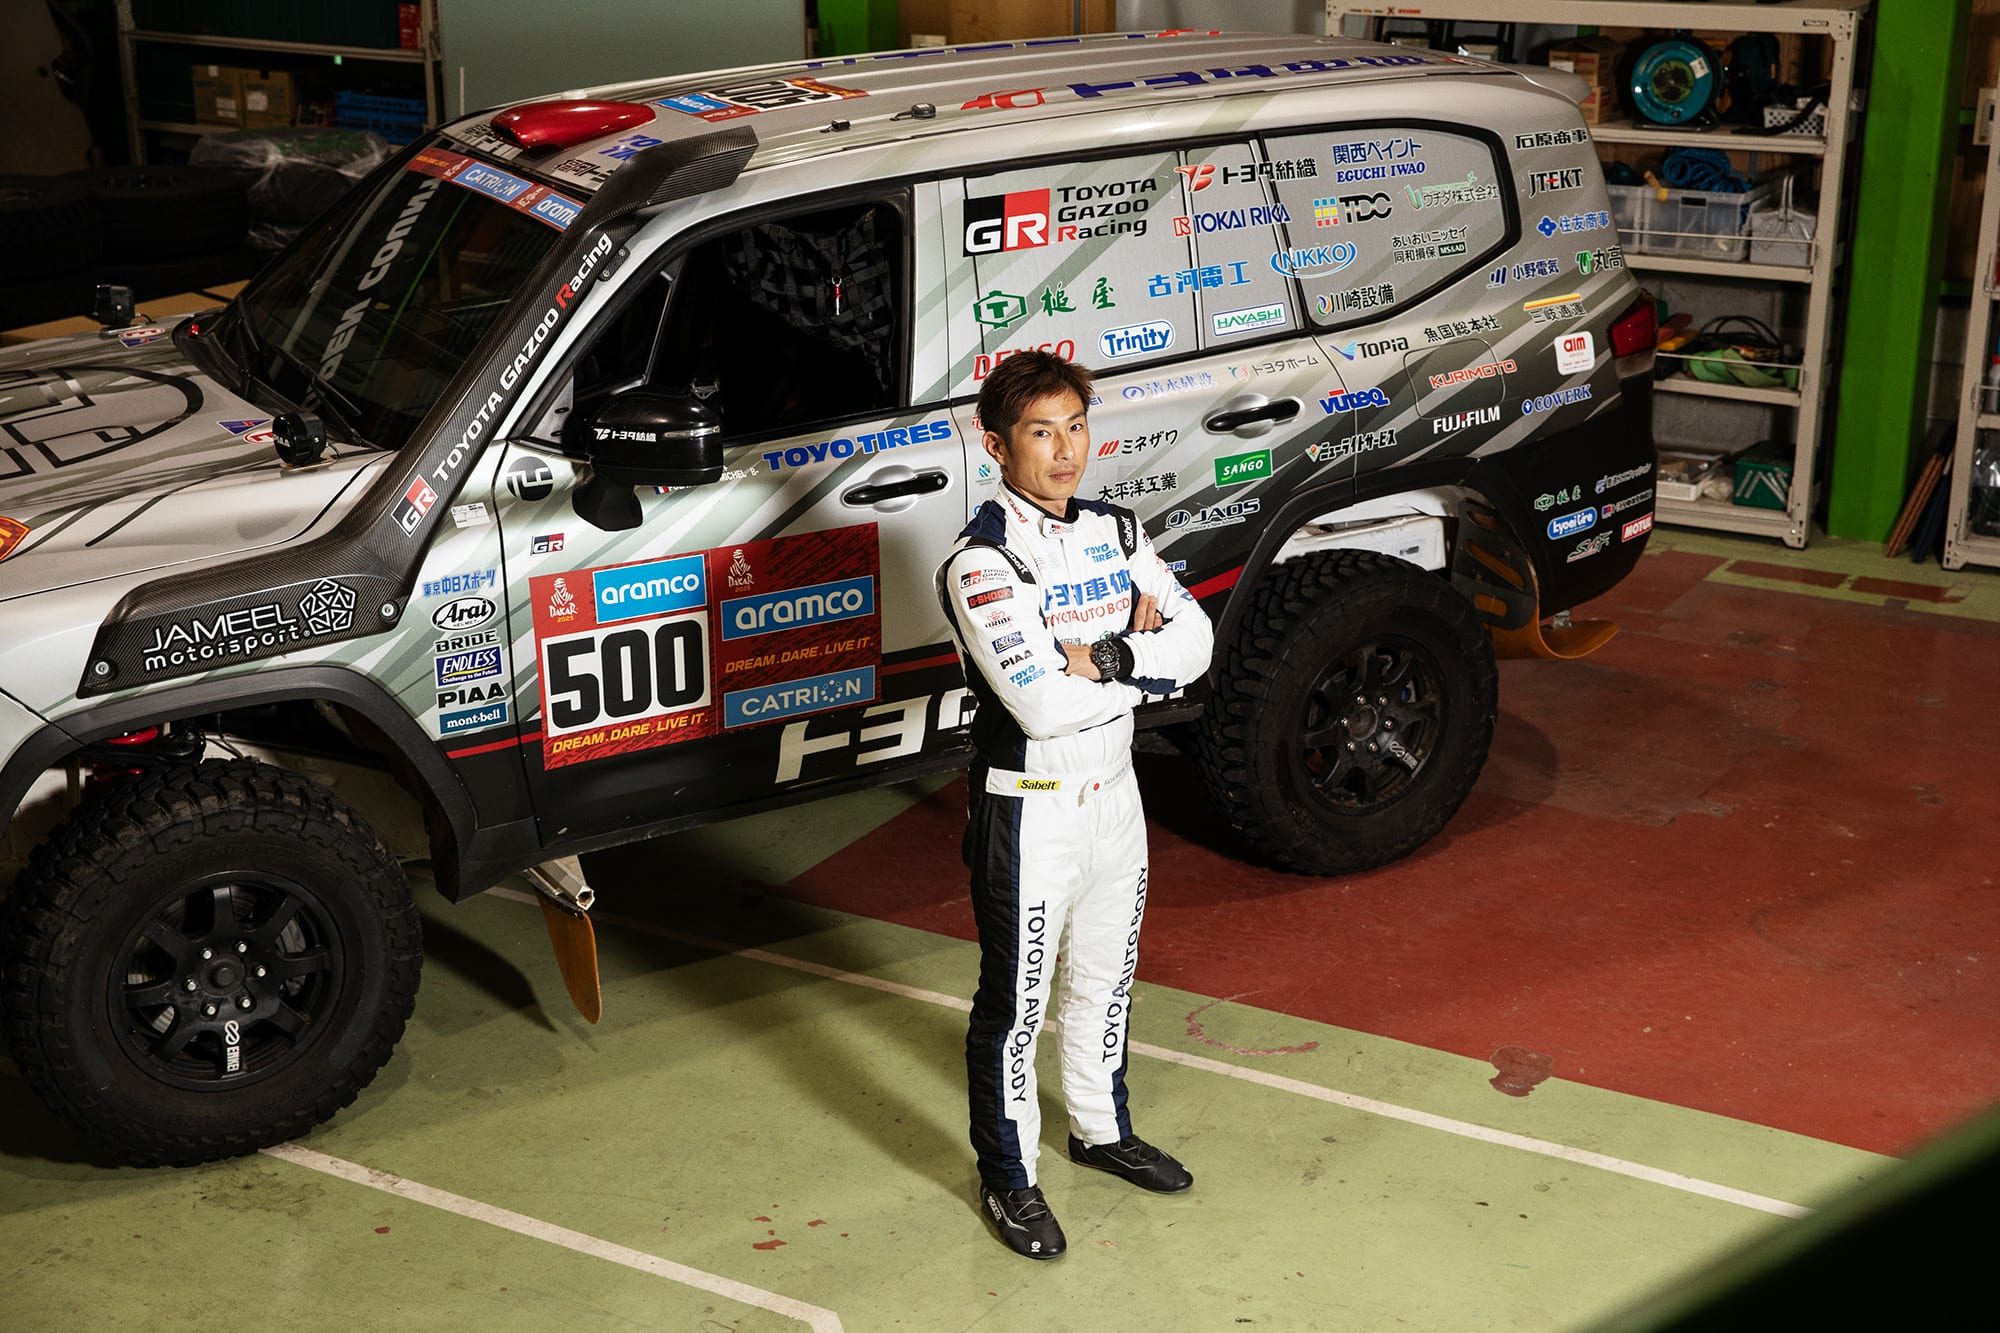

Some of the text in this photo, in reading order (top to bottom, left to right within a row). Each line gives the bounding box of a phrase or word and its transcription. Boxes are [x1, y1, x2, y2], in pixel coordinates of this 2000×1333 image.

[1332, 141, 1422, 165] 関西ペイント
[1223, 157, 1317, 184] トヨタ紡織
[1337, 162, 1425, 183] EGUCHI IWAO
[1529, 168, 1582, 197] JTEKT
[1057, 178, 1156, 204] TOYOTA
[1423, 185, 1499, 207] ウチダ株式会社
[1058, 199, 1150, 223] GAZOO
[1195, 208, 1247, 233] TOKAI
[1251, 203, 1291, 226] RIKA
[1339, 193, 1392, 223] TDC
[966, 212, 1049, 254] GR
[1058, 219, 1148, 243] Racing
[1560, 211, 1610, 232] 住友商事
[1392, 226, 1468, 248] あいおいニッセイ
[1283, 243, 1349, 270] NIKKO
[1394, 246, 1437, 263] 同和損保
[1593, 247, 1623, 271] 丸高
[1148, 261, 1252, 296] 古河電工
[1513, 259, 1559, 279] 小野電気
[1331, 283, 1395, 313] 川崎設備
[1217, 308, 1282, 329] HAYASHI
[1104, 326, 1171, 353] Trinity
[1564, 337, 1586, 352] aim
[1252, 355, 1319, 376] トヨタホーム
[1430, 360, 1517, 388] KURIMOTO
[402, 487, 437, 535] GR
[433, 392, 503, 482] TOYOTA
[500, 308, 559, 391] GAZOO
[555, 233, 613, 309] Racing
[1536, 386, 1592, 413] COWERK
[763, 438, 855, 471] TOYO
[857, 420, 953, 454] TIRES
[1122, 430, 1178, 455] ミネザワ
[1222, 459, 1264, 476] SANGO
[533, 541, 564, 555] GR
[1084, 543, 1109, 557] TOYO
[1092, 549, 1120, 564] TIRES
[423, 569, 496, 597] 東京中日スポーツ
[601, 573, 700, 605] aramco
[437, 599, 490, 625] Arai
[735, 588, 863, 630] aramco
[144, 604, 297, 653] JAMEEL
[146, 626, 299, 671] motorsport
[436, 630, 497, 654] BRIDE
[825, 640, 854, 656] LIVE
[442, 649, 498, 676] ENDLESS
[1000, 649, 1034, 670] PIAA
[547, 619, 705, 729] 500
[1009, 664, 1036, 683] TOYO
[1017, 667, 1046, 688] TIRES
[438, 682, 505, 709] PIAA
[657, 714, 689, 733] LIVE
[1020, 779, 1056, 791] Sabelt
[1130, 867, 1148, 928] BODY
[1024, 900, 1046, 992] TOYOTA
